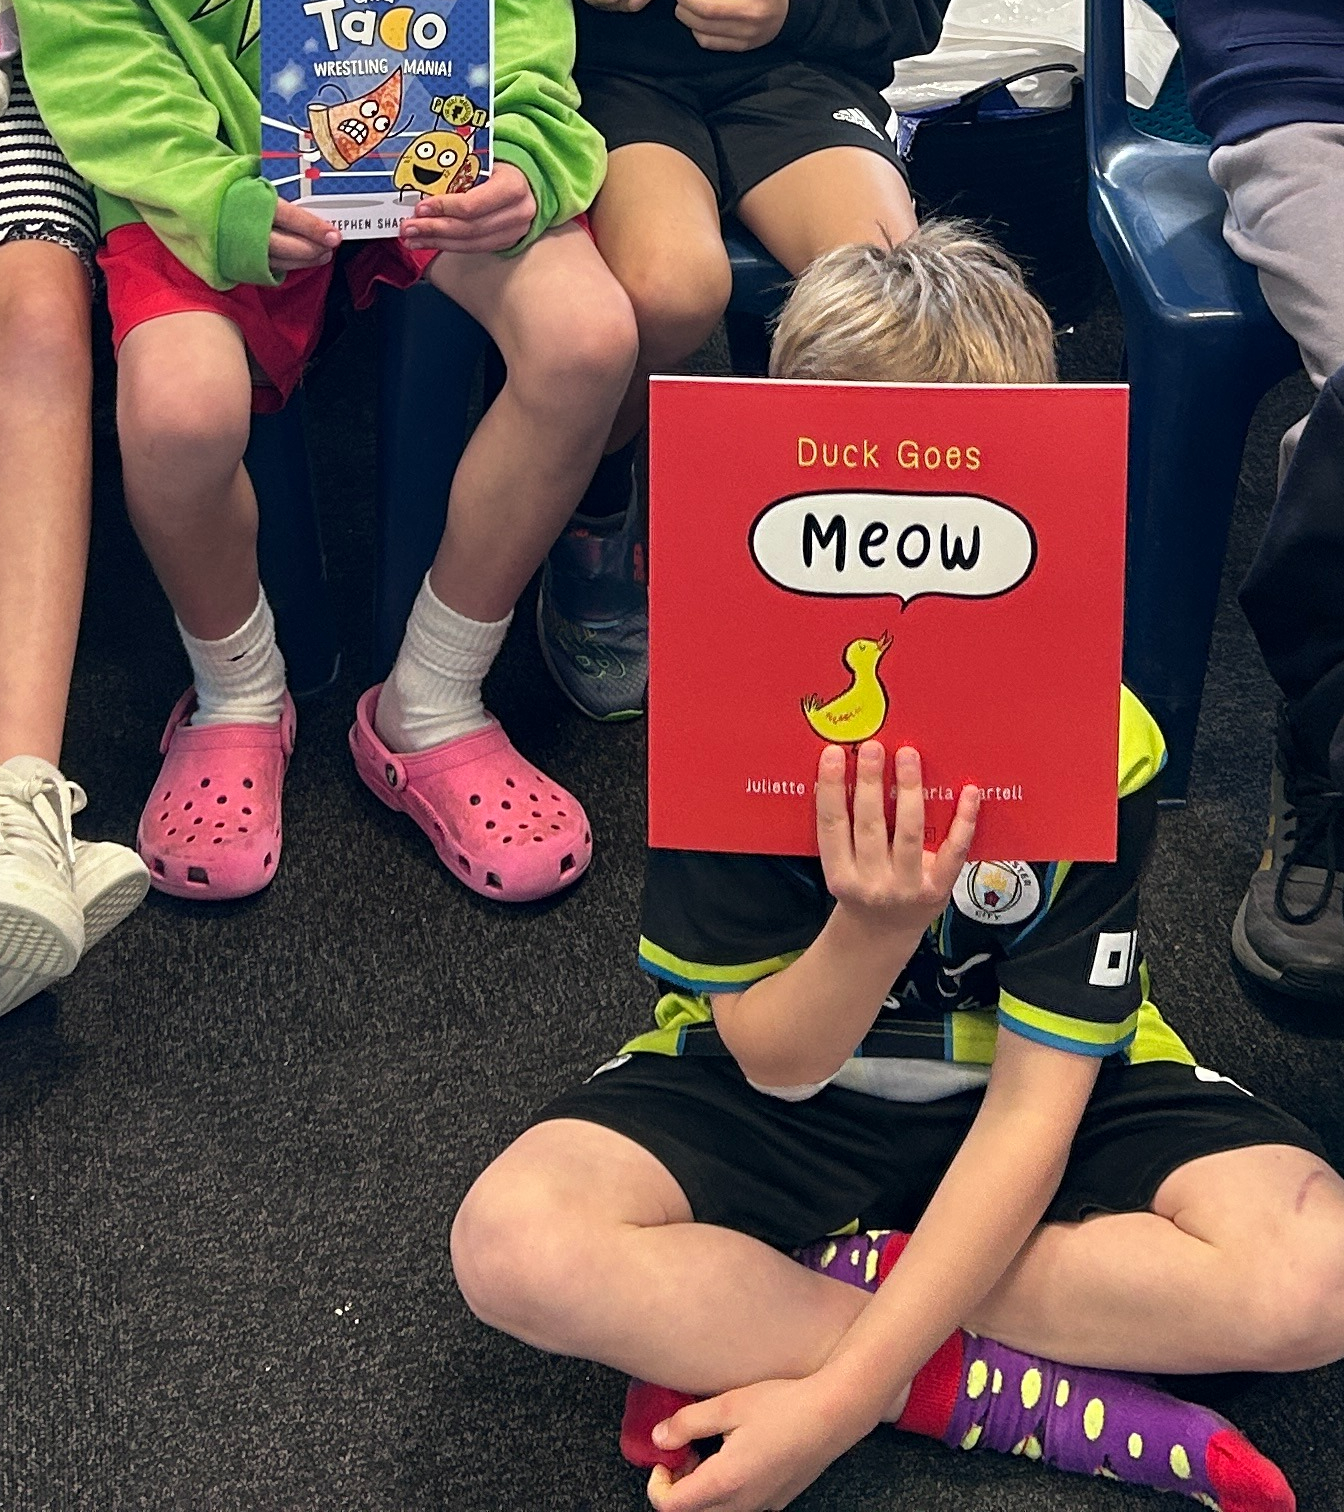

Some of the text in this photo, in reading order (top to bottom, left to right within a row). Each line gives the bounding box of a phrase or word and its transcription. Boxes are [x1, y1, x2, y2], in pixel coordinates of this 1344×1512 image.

[314, 58, 453, 78] WRESTLING MANIA!
[330, 218, 372, 231] TEPHEN
[797, 435, 982, 471] Duck Goes
[802, 512, 982, 573] Meow
[922, 785, 954, 801] arla
[976, 784, 1023, 800] artell
